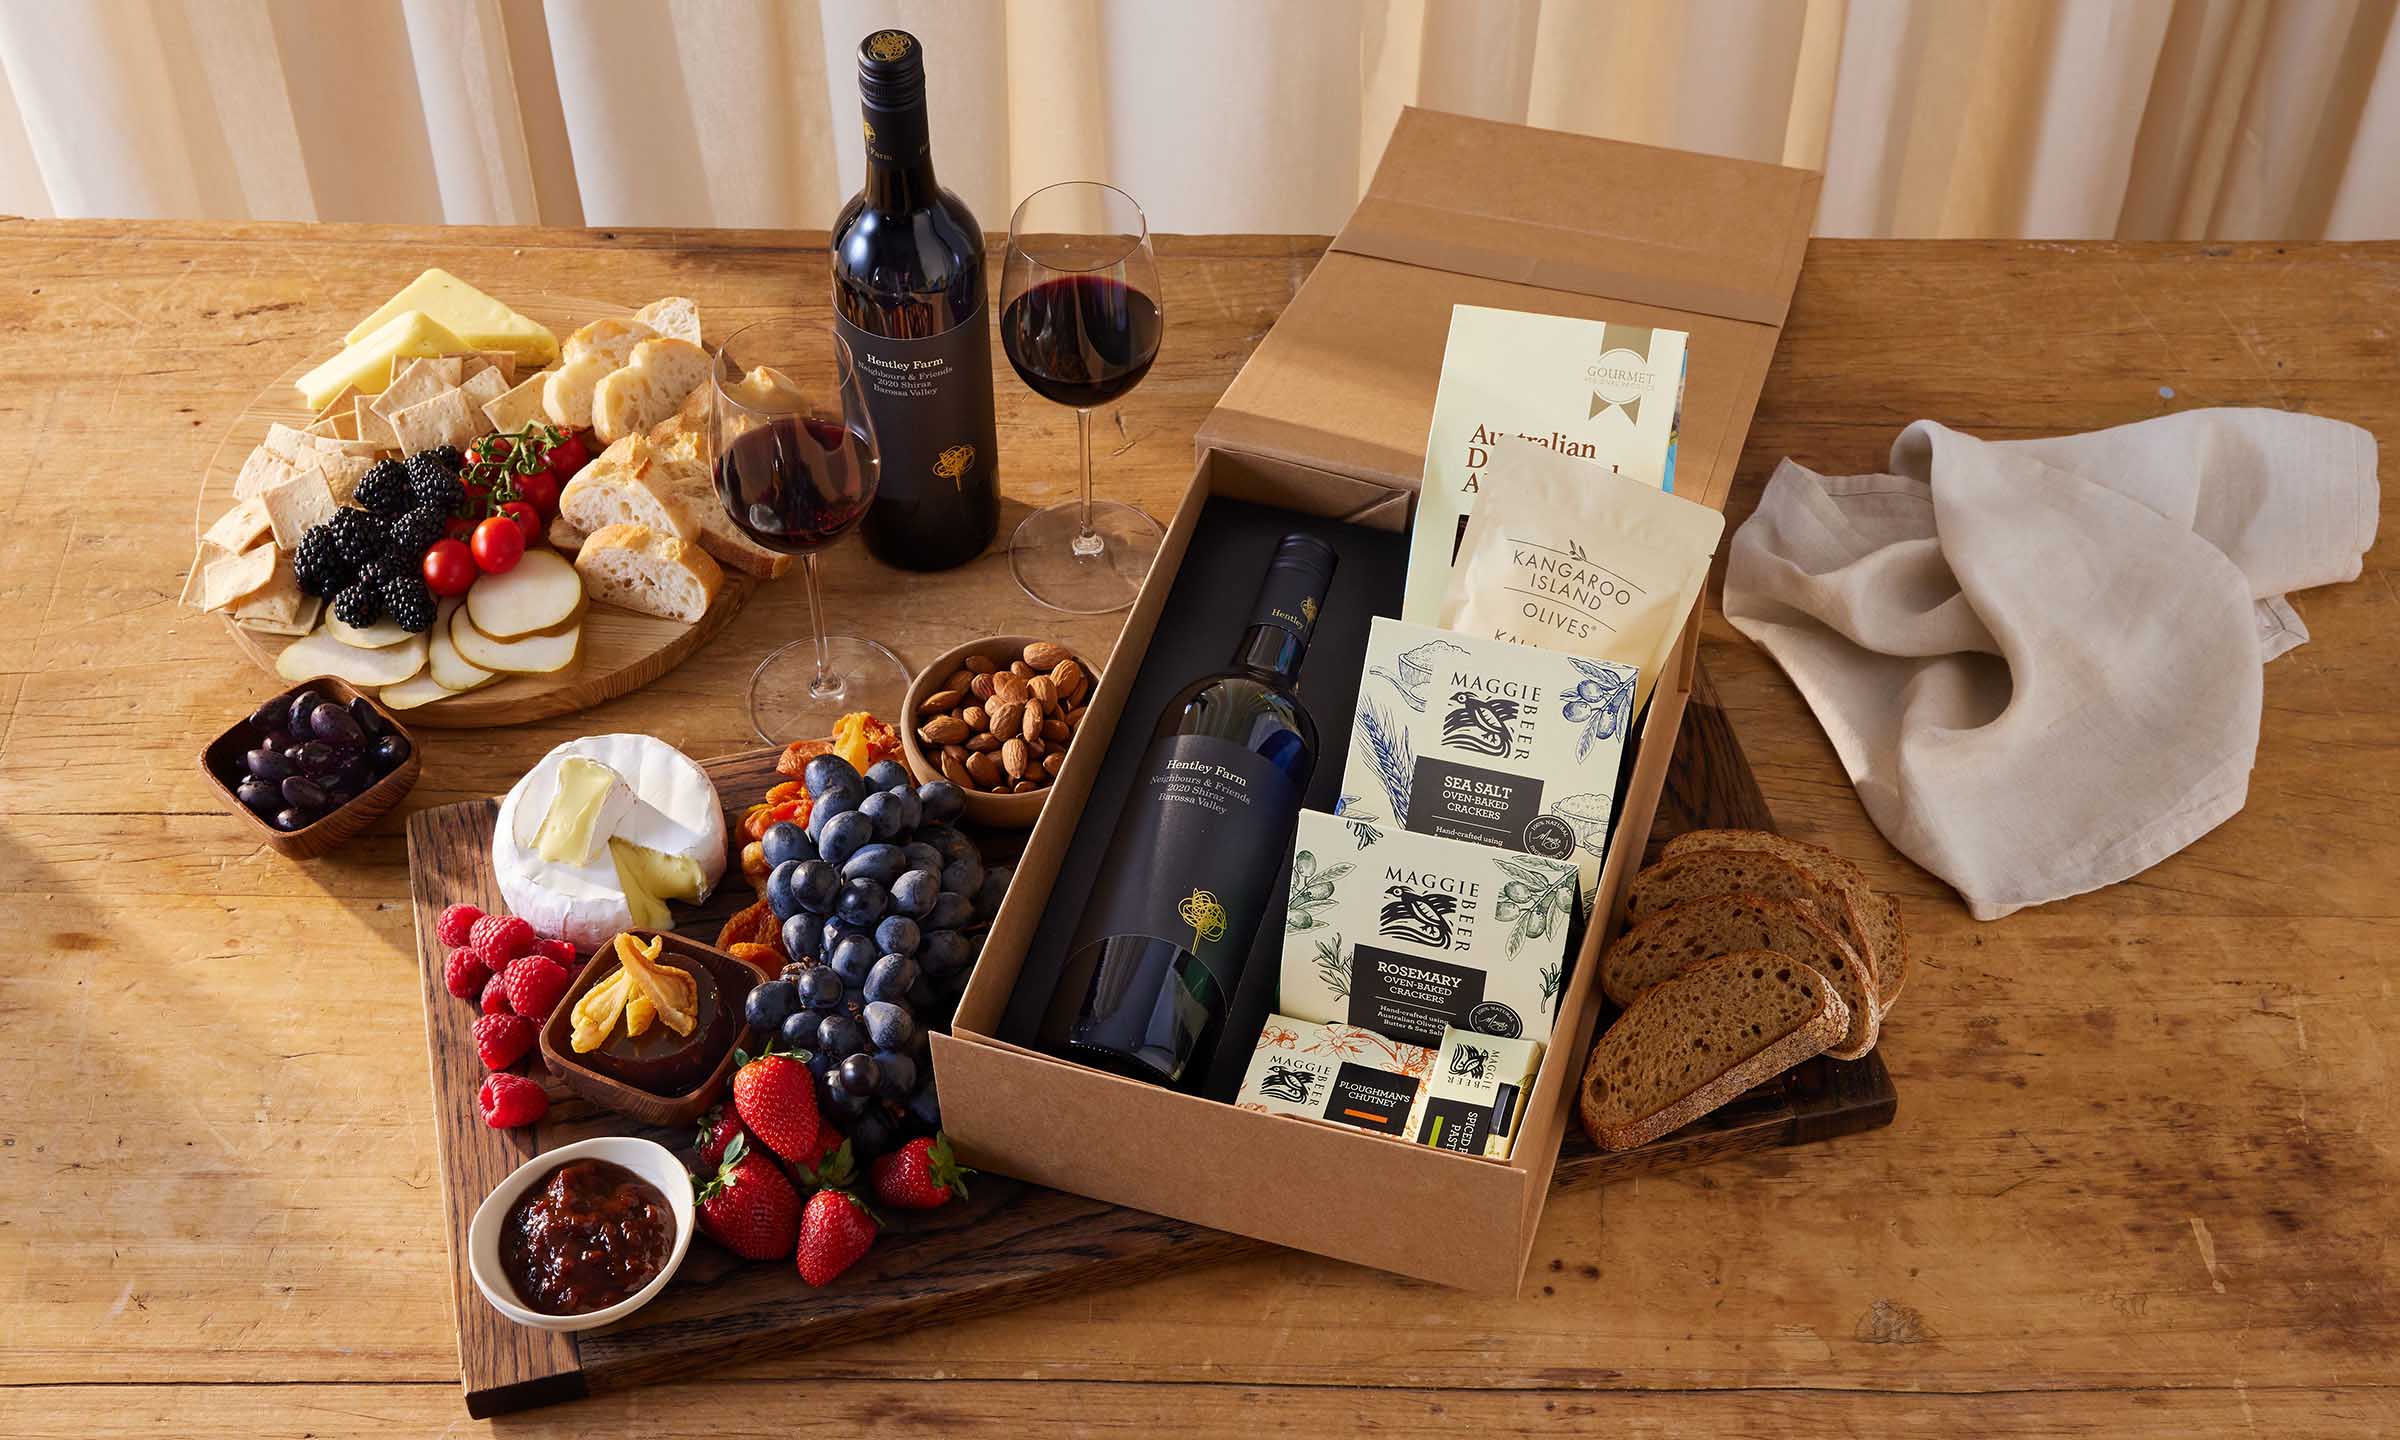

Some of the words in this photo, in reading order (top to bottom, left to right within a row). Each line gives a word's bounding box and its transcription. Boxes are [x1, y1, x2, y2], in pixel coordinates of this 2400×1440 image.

[857, 360, 906, 381] Neighbours
[907, 373, 917, 381] &
[919, 366, 953, 380] Friends
[866, 353, 910, 372] Hentley
[912, 358, 944, 370] Farm
[877, 377, 899, 388] 2020
[901, 380, 932, 389] Shiraz
[1587, 366, 1656, 385] GOURMET
[873, 383, 909, 396] Barossa
[909, 387, 938, 397] Valley
[1513, 549, 1631, 605] KANGAROO
[1530, 573, 1602, 610] ISLAND
[1271, 608, 1305, 630] Hentley
[1450, 671, 1542, 703] MAGGIE
[1513, 704, 1538, 761] BEER
[1166, 760, 1213, 775] Hentley
[1214, 765, 1248, 787] Farm
[1150, 774, 1201, 785] Neighbours
[1203, 779, 1213, 787] &
[1214, 782, 1252, 805] Friends
[1167, 783, 1190, 793] 2020
[1191, 786, 1225, 804] Shiraz
[1444, 775, 1472, 792] SEA
[1474, 782, 1513, 800] SALT
[1158, 793, 1196, 805] Barossa
[1197, 798, 1228, 815] Valley
[1442, 790, 1509, 811] OVEN-BAKED
[1447, 802, 1501, 821] CRACKERS
[1435, 826, 1483, 842] Hand-crafted
[1483, 837, 1504, 847] using
[1545, 819, 1569, 838] NATURAL
[1385, 866, 1480, 898] MAGGIE
[1454, 899, 1478, 953] BEER
[1377, 961, 1462, 988] ROSEMARY
[1383, 975, 1453, 996] OVEN-BAKED
[1389, 986, 1445, 1005] CRACKERS
[1377, 1011, 1415, 1025] Australian
[1416, 1019, 1437, 1029] Olive
[1380, 1005, 1428, 1020] Hand-crafted
[1428, 1015, 1449, 1026] using
[1383, 1018, 1407, 1029] Butter
[1414, 1025, 1428, 1034] Sea
[1270, 1055, 1332, 1076] MAGGIE
[1481, 1049, 1501, 1089] MAGGIE
[1308, 1075, 1328, 1106] BEER
[1339, 1080, 1411, 1103] PLOUGHMAN'S
[1348, 1091, 1397, 1108] CHUTNEY
[1460, 1111, 1479, 1147] SPICED
